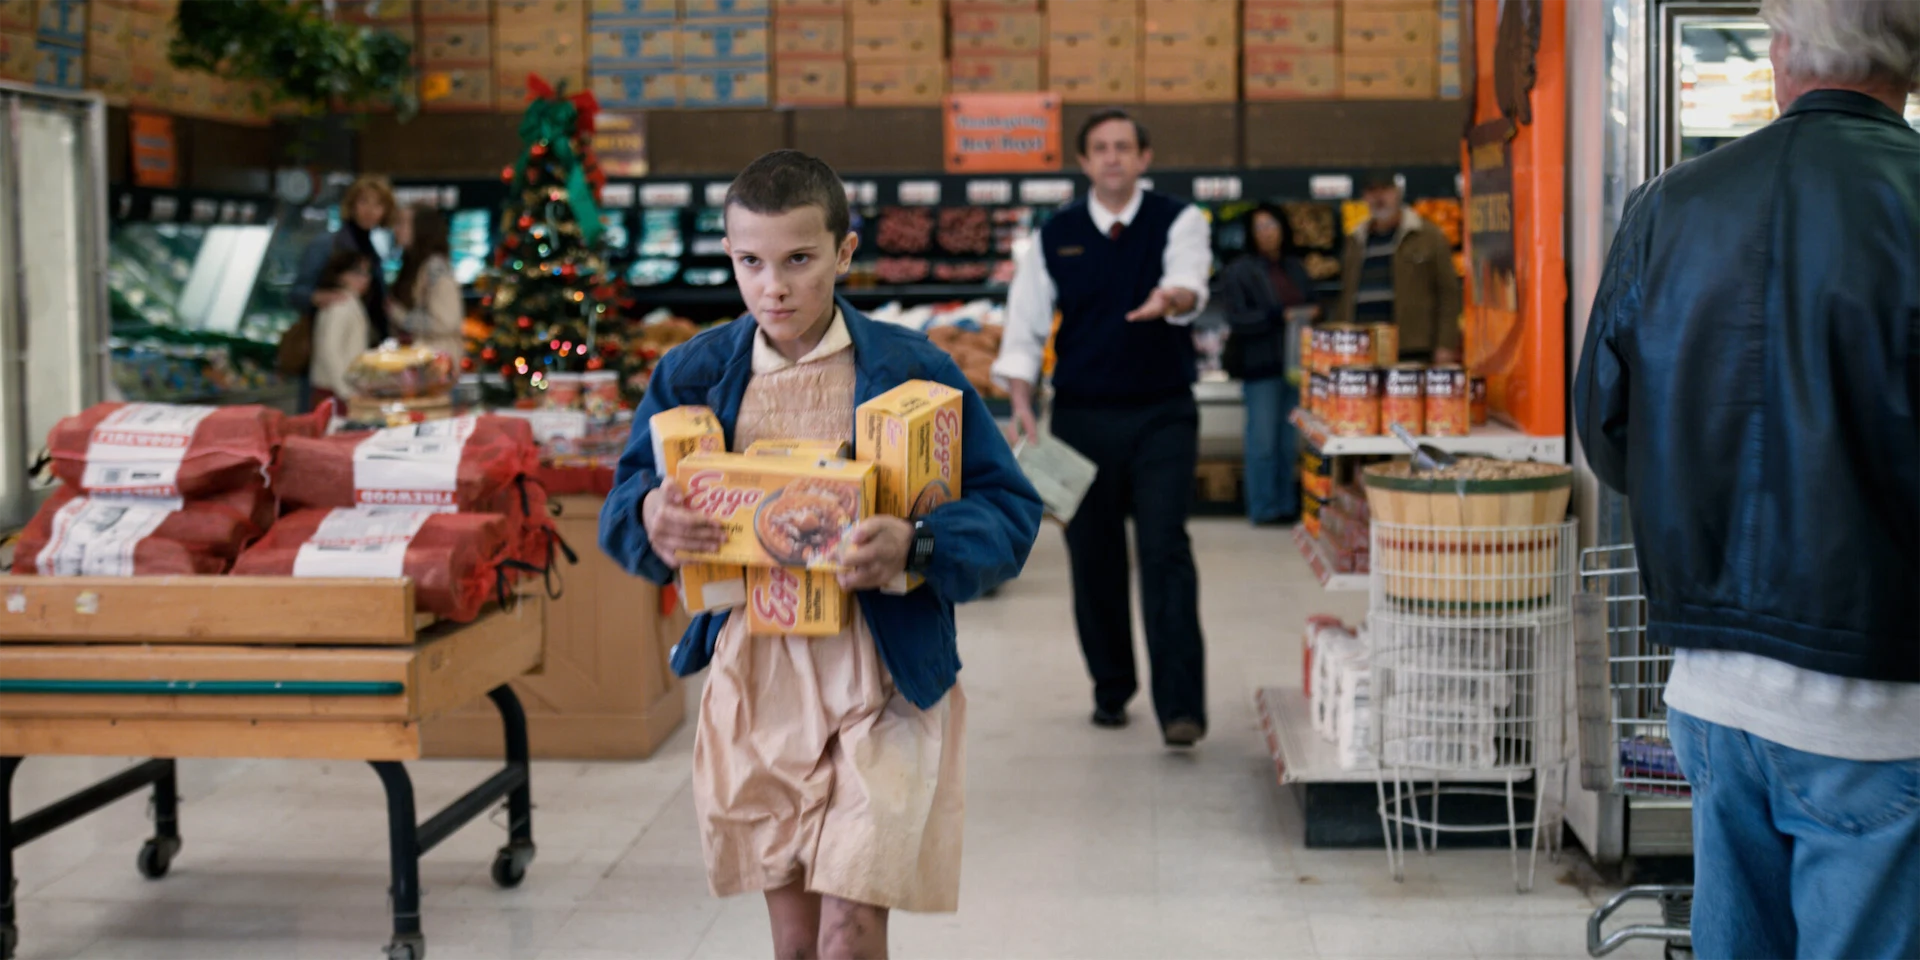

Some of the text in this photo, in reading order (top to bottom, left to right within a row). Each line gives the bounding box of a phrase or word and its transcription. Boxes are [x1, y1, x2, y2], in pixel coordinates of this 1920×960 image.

[99, 432, 185, 447] FIREWOOD
[934, 407, 960, 482] Eggo
[360, 490, 452, 504] FIREWOOD
[685, 471, 763, 517] Eggo
[753, 567, 800, 628] Egg
